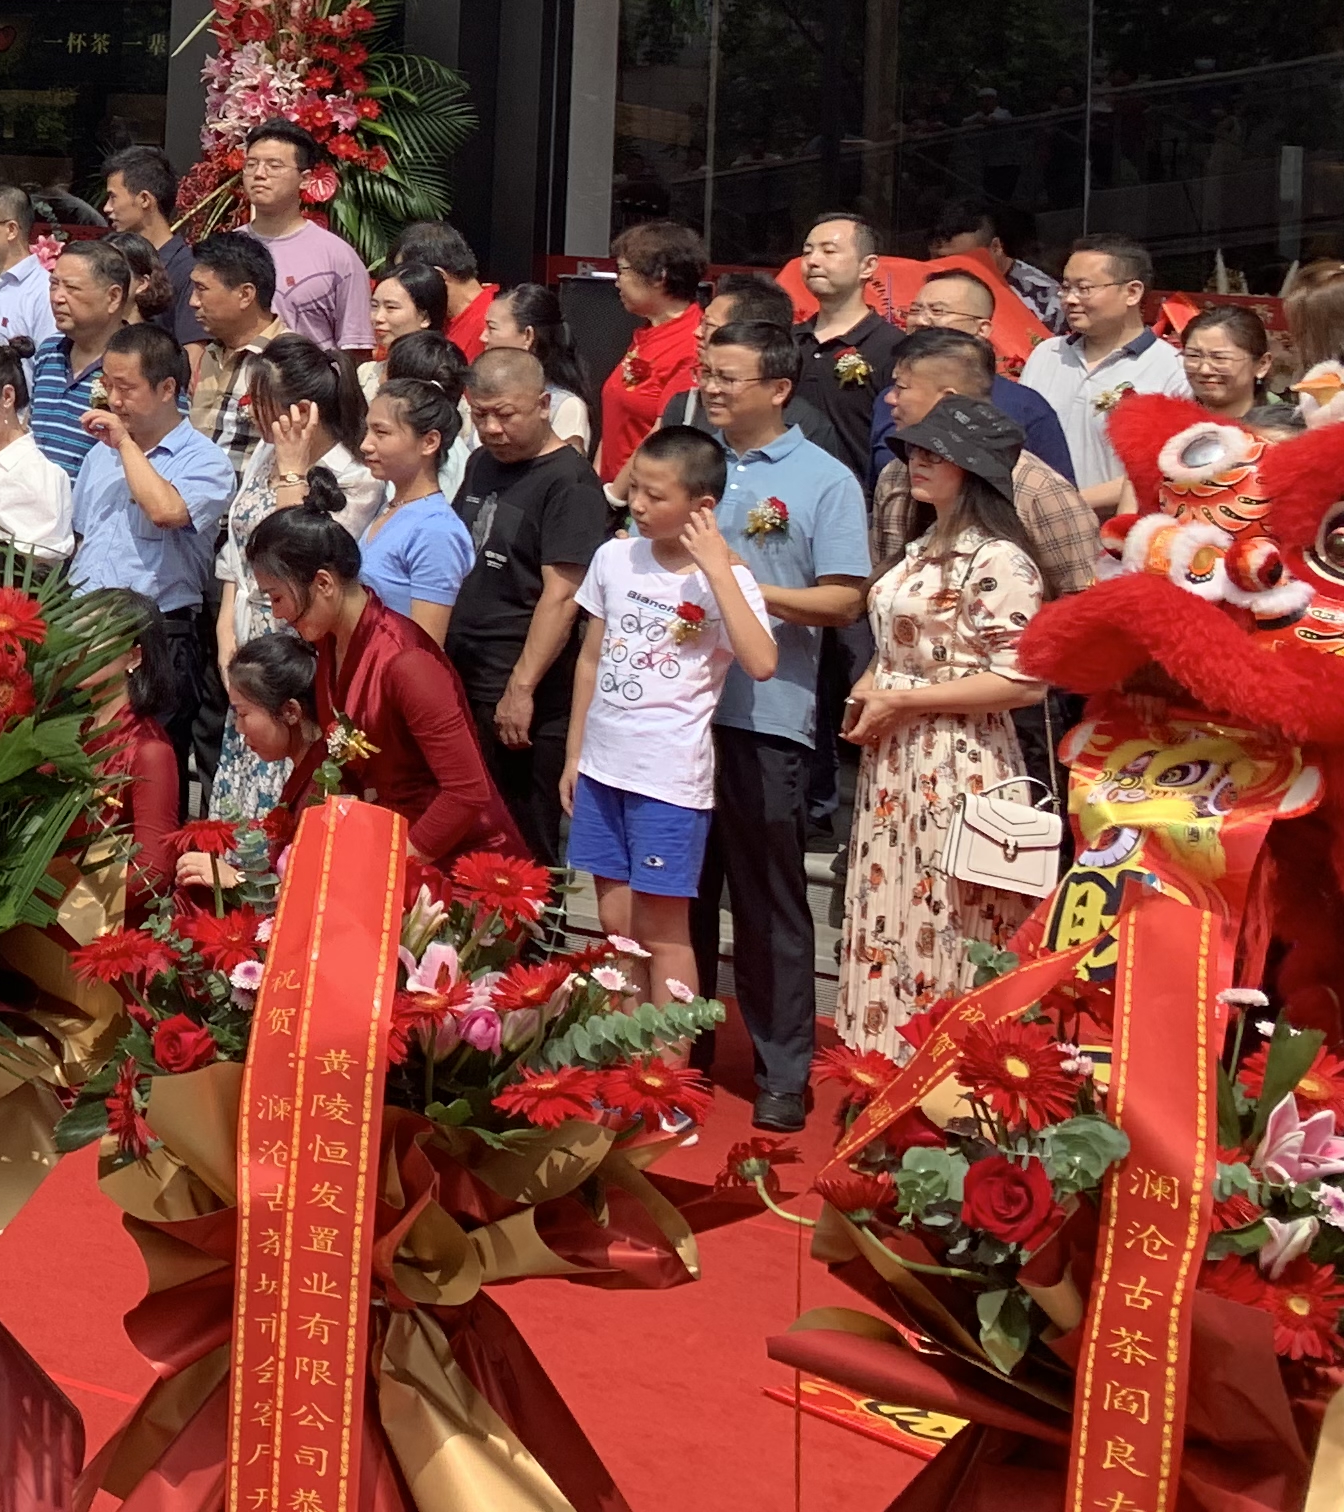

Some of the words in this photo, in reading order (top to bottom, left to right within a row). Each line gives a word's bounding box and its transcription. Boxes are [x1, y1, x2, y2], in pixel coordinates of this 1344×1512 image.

[43, 32, 112, 55] 一杯茶
[626, 590, 678, 614] Bianch
